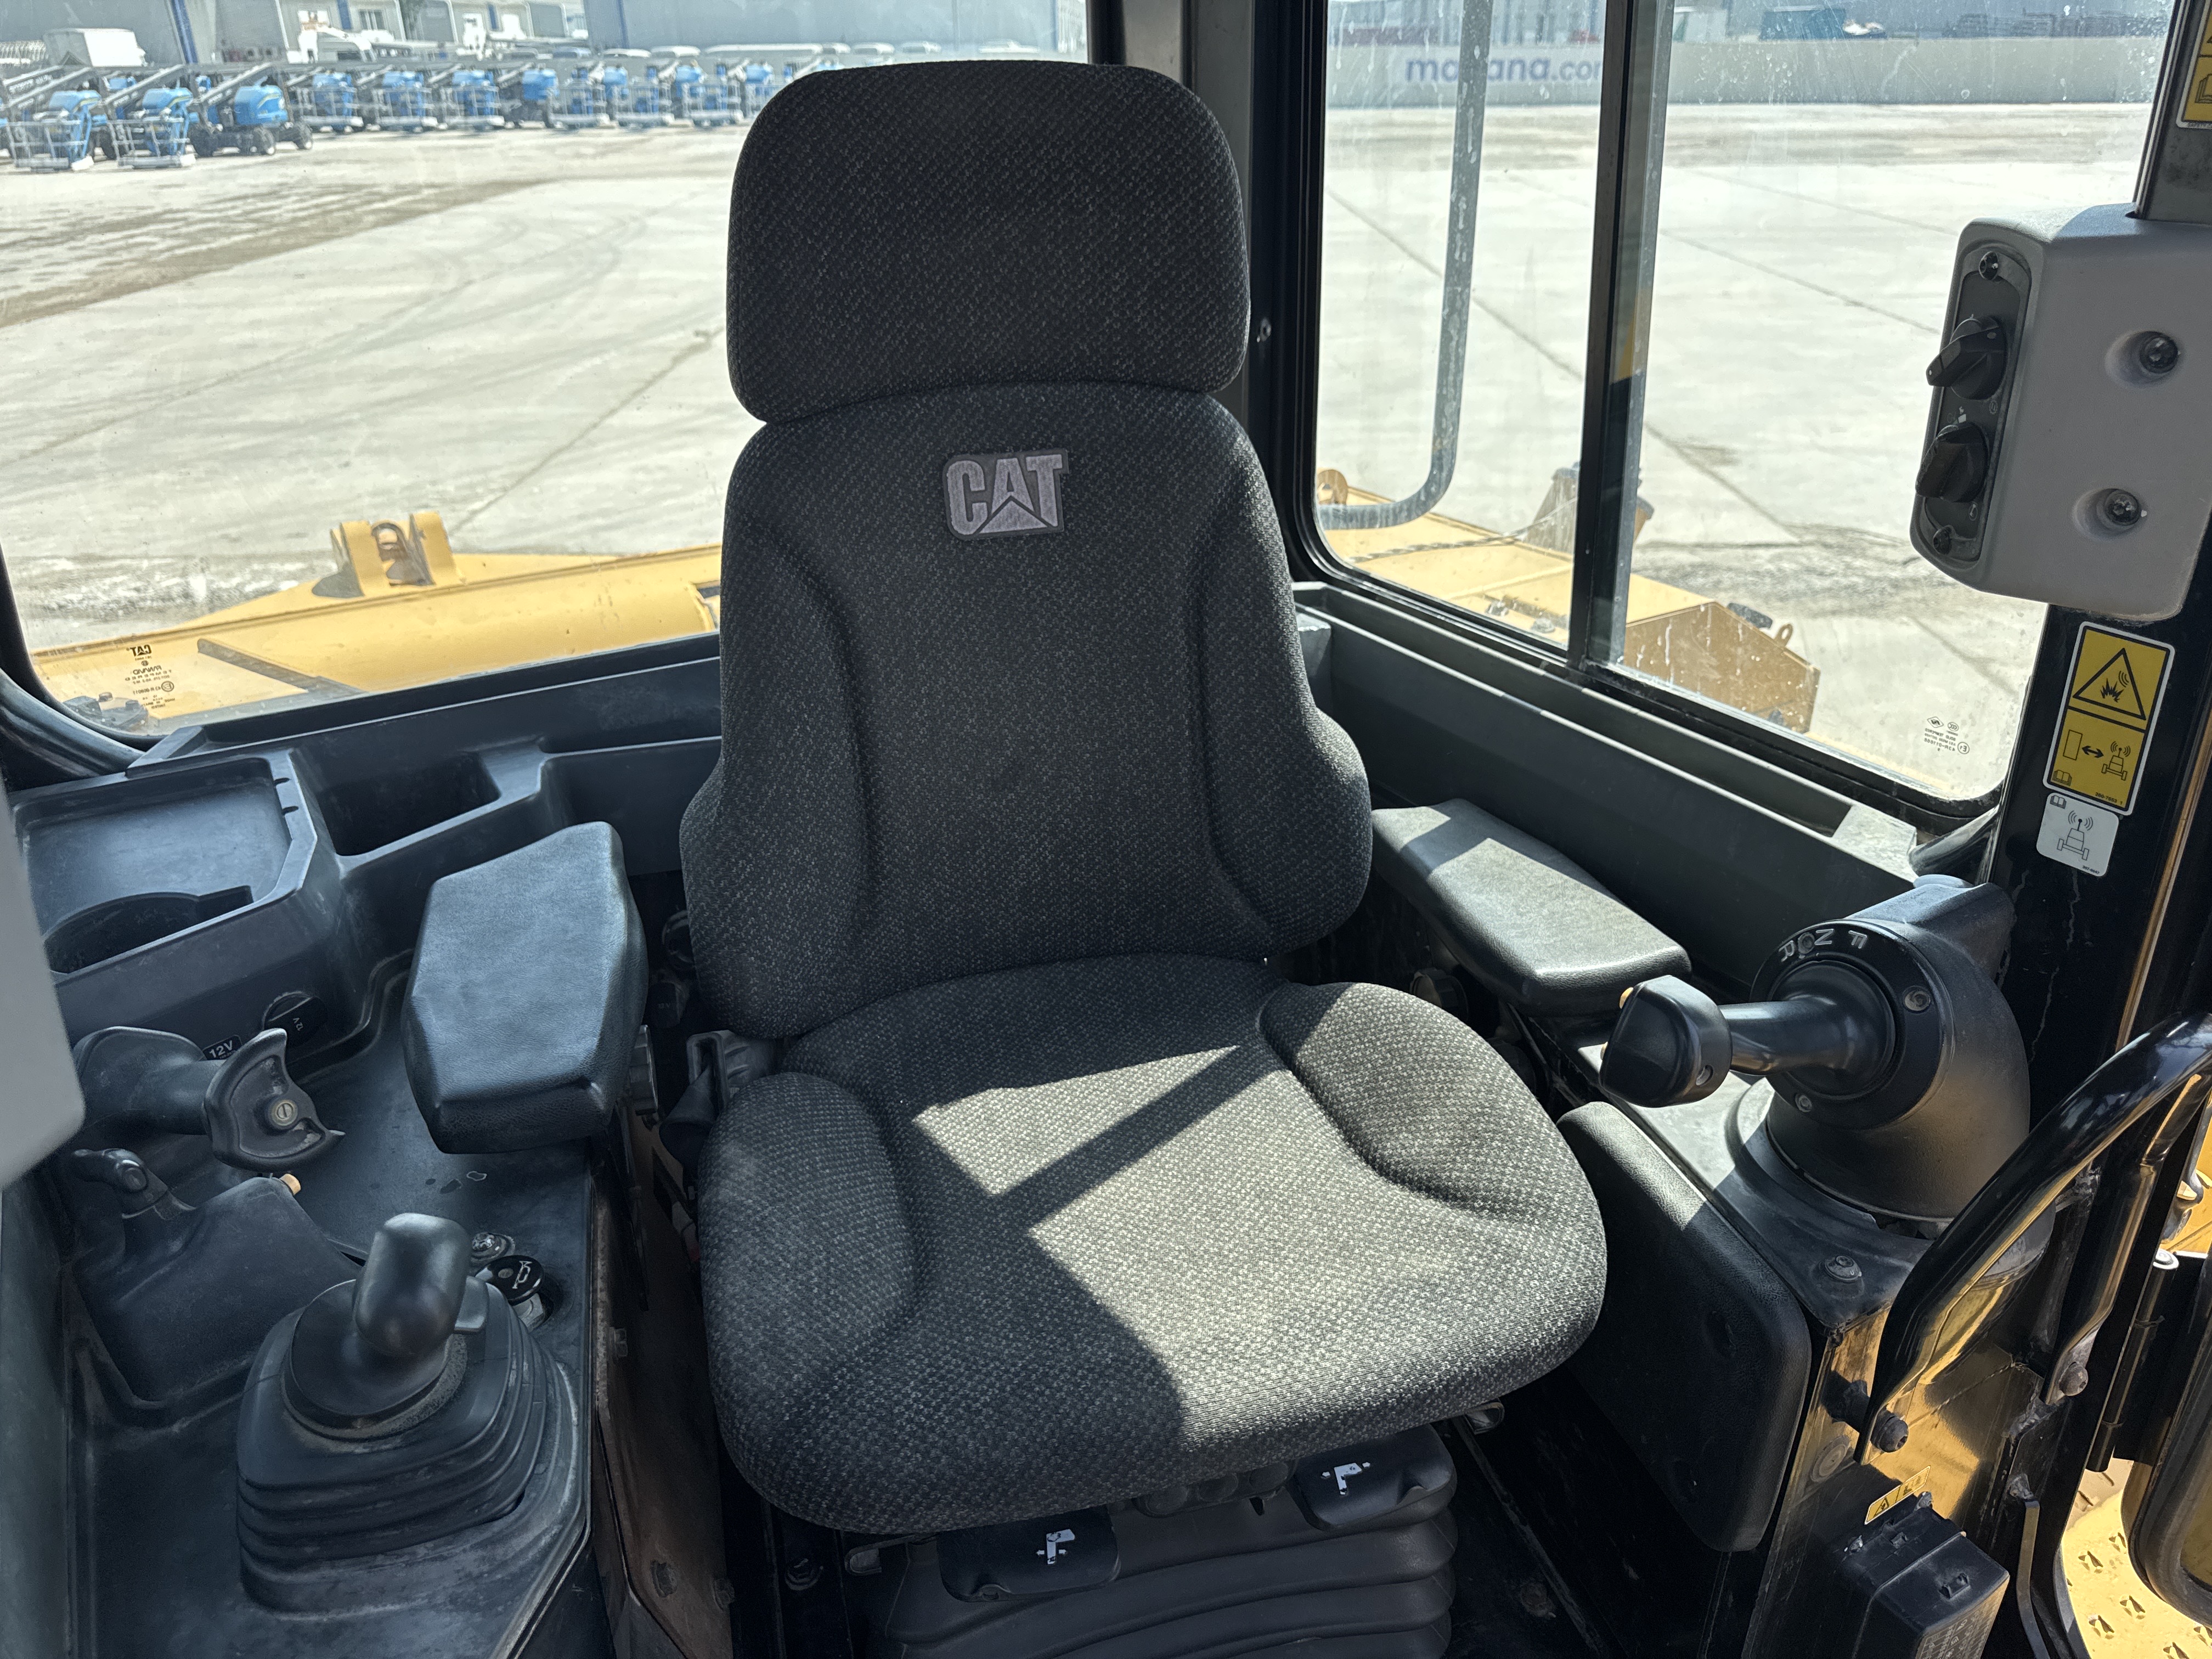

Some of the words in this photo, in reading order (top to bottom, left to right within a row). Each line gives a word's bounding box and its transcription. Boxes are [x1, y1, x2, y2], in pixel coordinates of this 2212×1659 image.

[946, 454, 1063, 535] CAT
[1778, 940, 1795, 962] R
[209, 1040, 233, 1058] 12V
